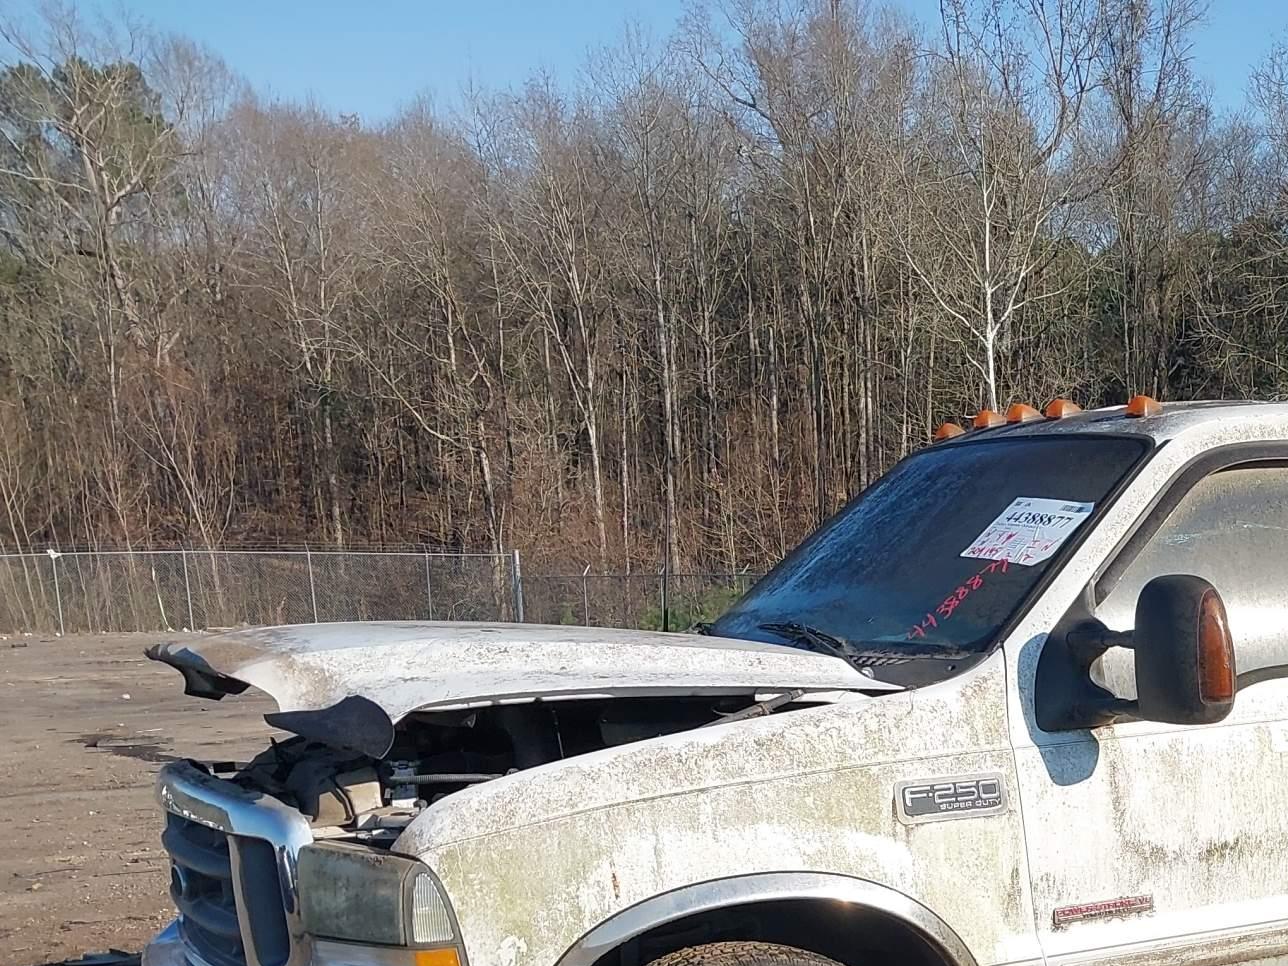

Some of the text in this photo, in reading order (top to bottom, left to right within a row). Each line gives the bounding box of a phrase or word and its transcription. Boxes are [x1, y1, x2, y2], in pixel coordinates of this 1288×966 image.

[1006, 511, 1074, 528] 44388877
[940, 798, 1000, 810] SUPER DUTY
